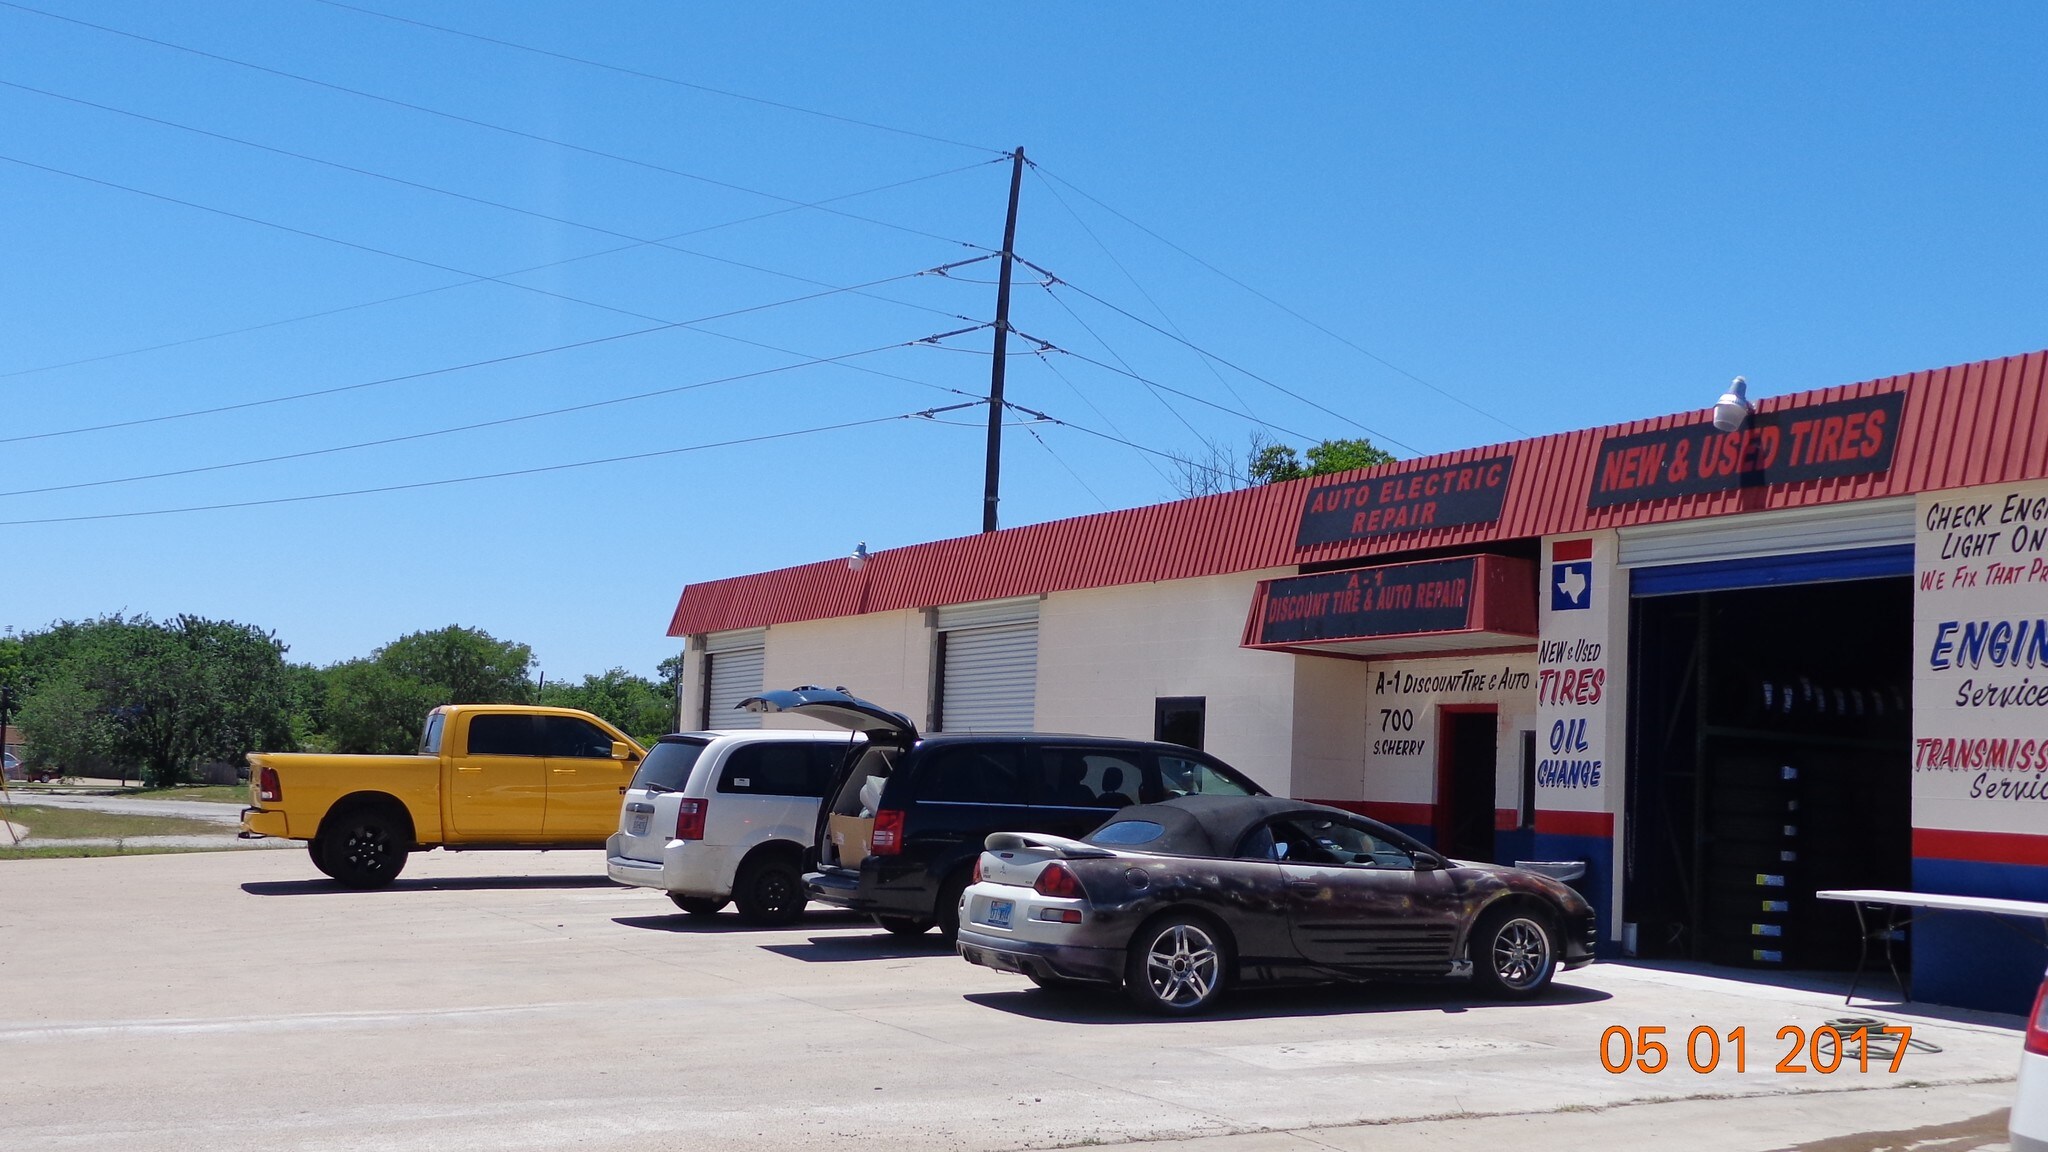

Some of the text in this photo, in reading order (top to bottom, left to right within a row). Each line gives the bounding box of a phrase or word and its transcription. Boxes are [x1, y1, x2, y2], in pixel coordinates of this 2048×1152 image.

[1600, 409, 1887, 492] NEW & USED TIRES
[1310, 463, 1503, 514] AUTO ELECTRIC
[1351, 501, 1437, 534] REPAIR
[1926, 503, 1992, 531] CHECK
[1941, 524, 2048, 560] LIGHT ON
[1920, 570, 1945, 591] WE
[1952, 565, 1977, 588] FIX
[1987, 562, 2026, 586] THAT
[1268, 577, 1467, 624] DISCOUNT TIRE & AUTO REPAIR
[1538, 638, 1602, 665] NEW & USED
[1376, 670, 1401, 695] A-1
[1488, 674, 1497, 690] &
[1498, 667, 1530, 690] AUTO
[1539, 667, 1606, 707] TIRES
[1955, 678, 2048, 707] Service
[1380, 708, 1414, 732] 700
[1550, 718, 1589, 755] OIL
[1537, 759, 1602, 789] CHANGE
